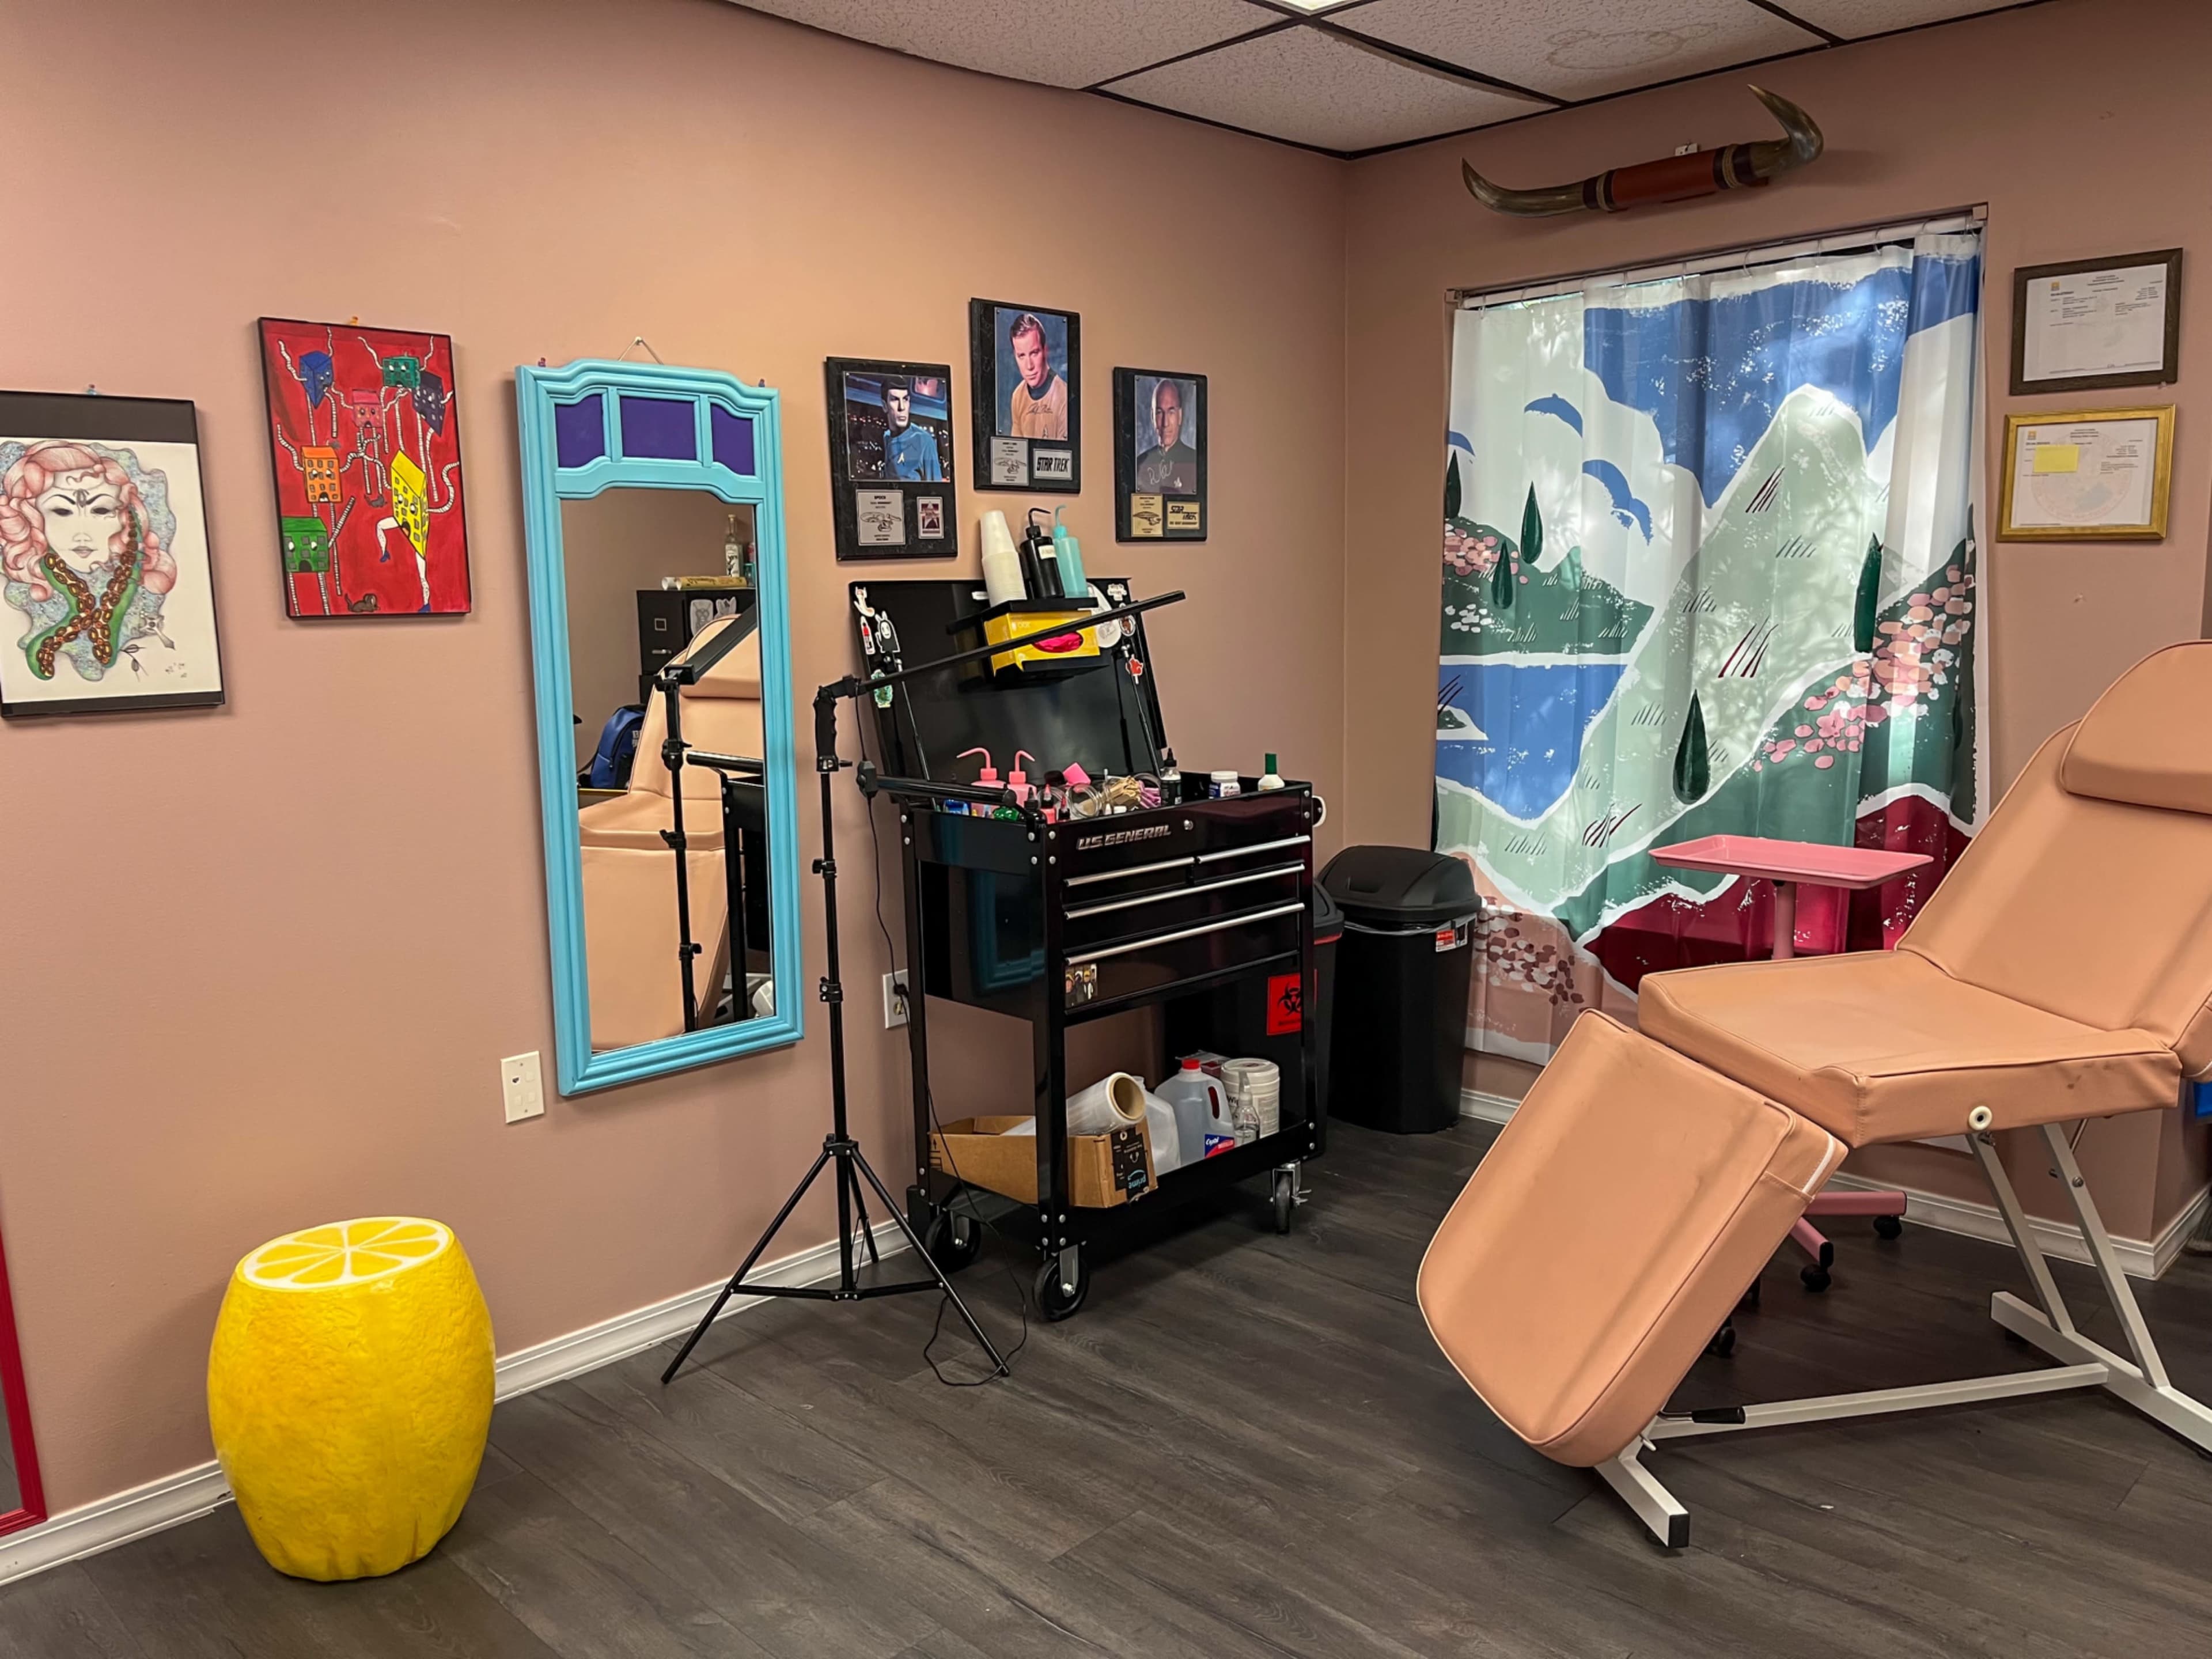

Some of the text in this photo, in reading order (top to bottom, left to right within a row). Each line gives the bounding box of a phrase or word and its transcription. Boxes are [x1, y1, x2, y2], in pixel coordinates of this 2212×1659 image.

[1037, 457, 1070, 472] STAR TREK
[1104, 825, 1172, 846] GENERAL
[1128, 1174, 1147, 1190] prime
